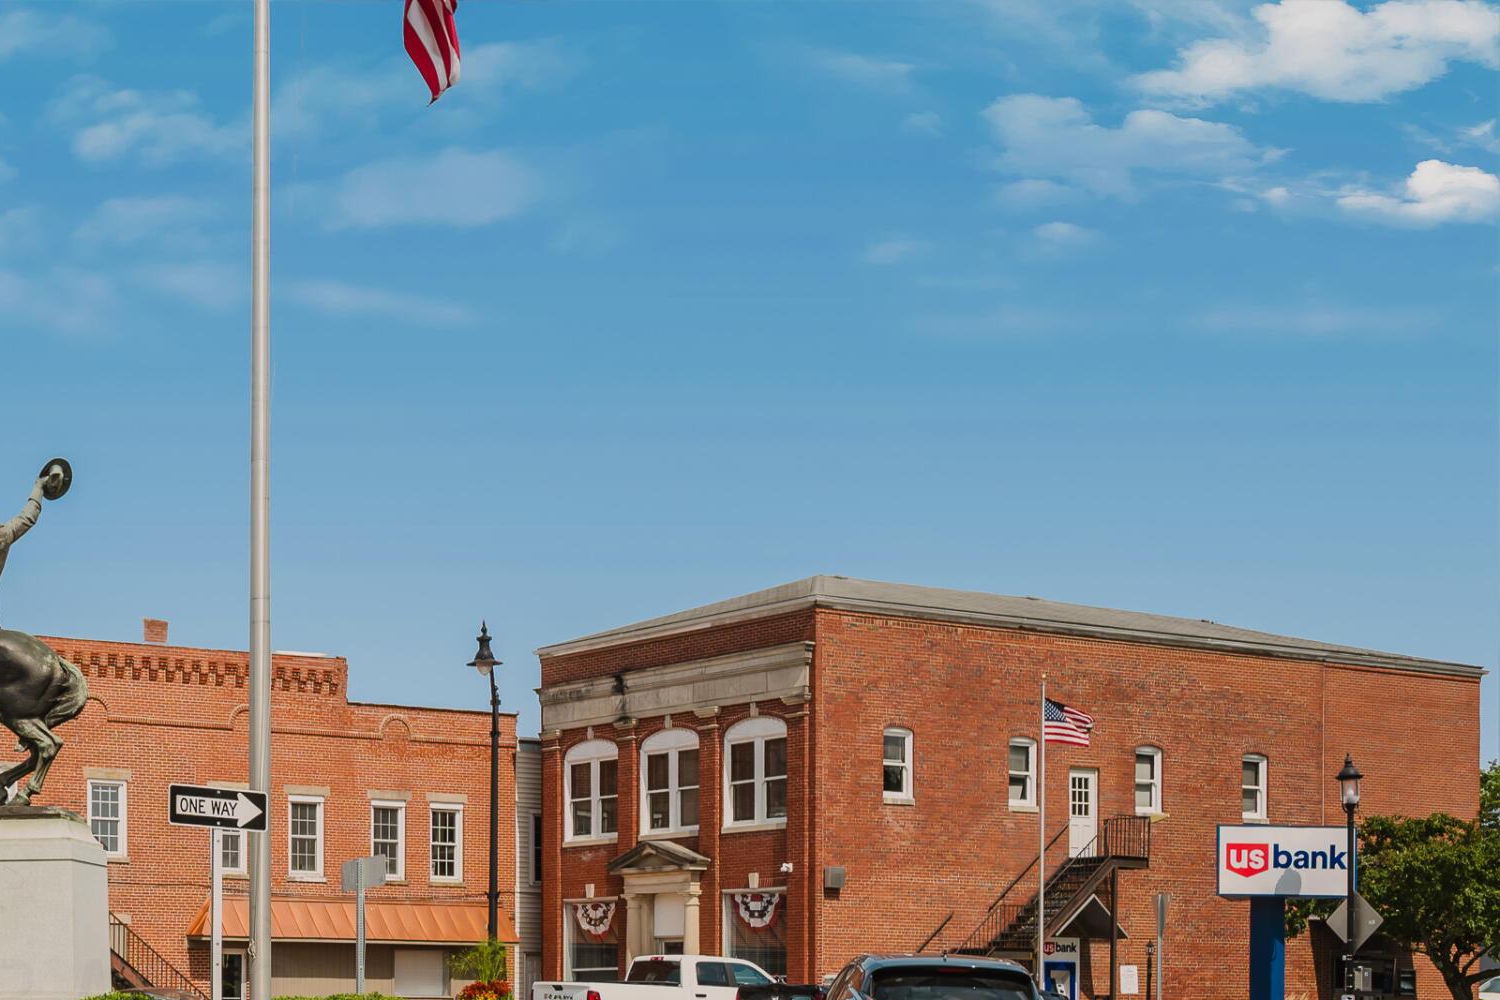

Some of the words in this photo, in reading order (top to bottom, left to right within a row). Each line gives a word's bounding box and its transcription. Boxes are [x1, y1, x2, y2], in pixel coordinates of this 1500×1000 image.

[180, 797, 206, 814] ONE
[211, 800, 238, 816] WAY
[1273, 843, 1348, 870] bank
[1055, 942, 1077, 953] bank
